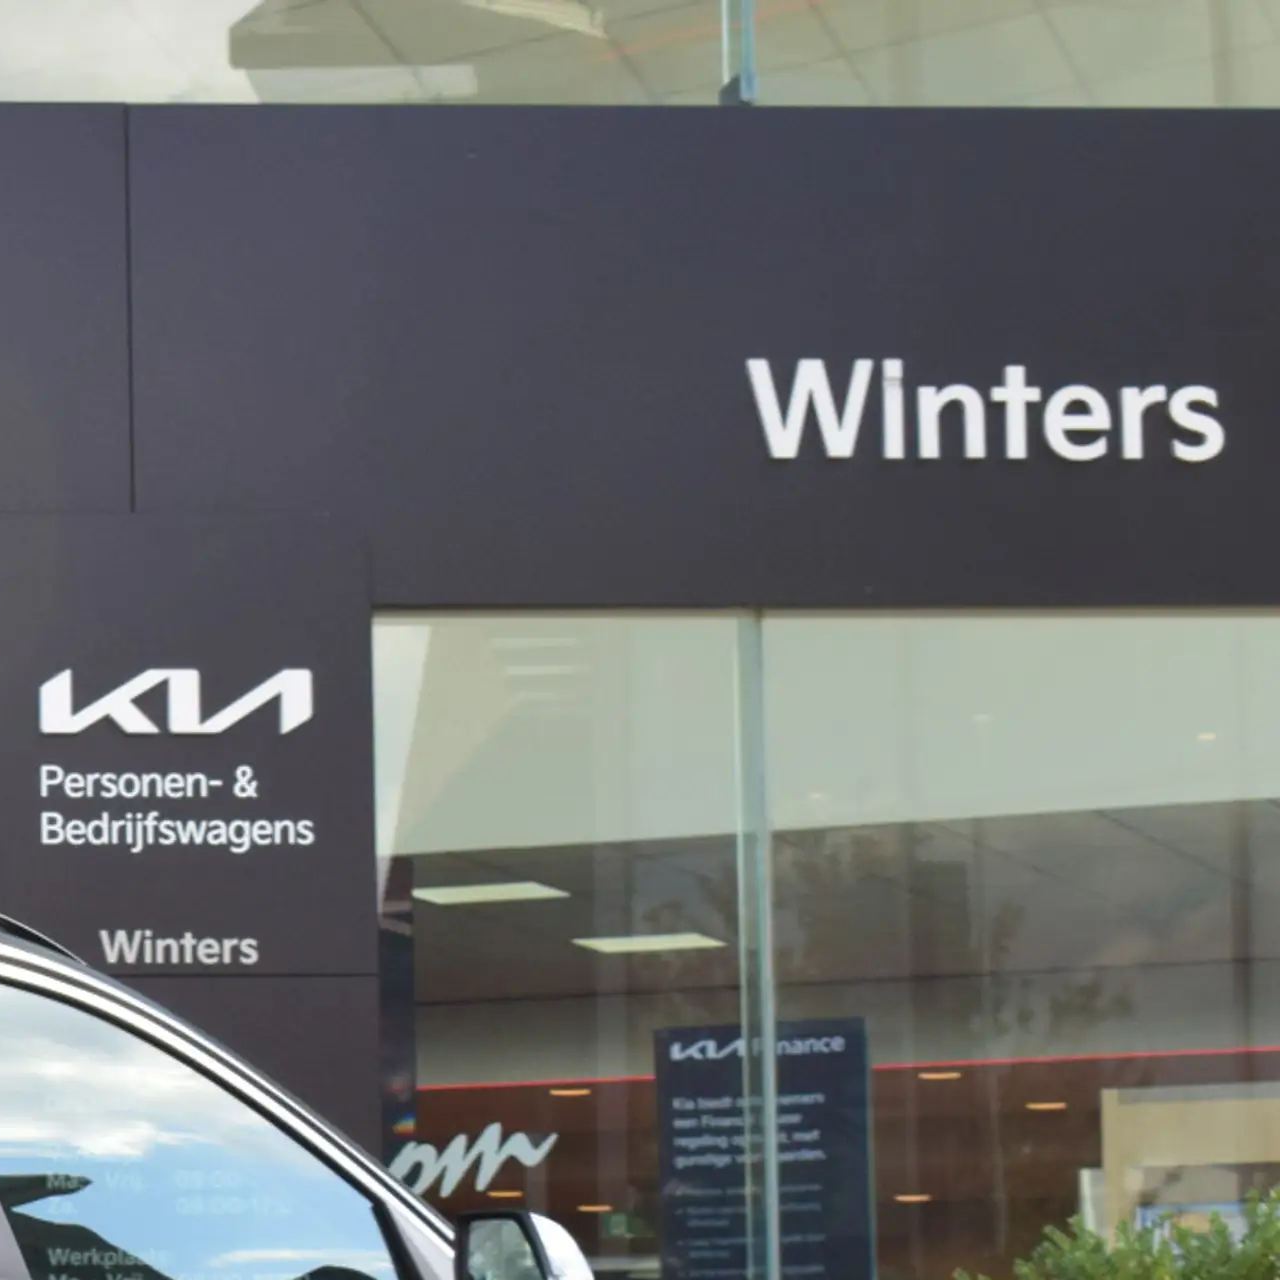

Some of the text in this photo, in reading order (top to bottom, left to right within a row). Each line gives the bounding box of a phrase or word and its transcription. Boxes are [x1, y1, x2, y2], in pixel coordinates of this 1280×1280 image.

[746, 358, 1225, 462] Winters
[39, 668, 313, 734] KIA
[39, 764, 258, 799] Personen- &
[40, 810, 315, 854] Bedrijfswagens
[99, 929, 259, 965] Winters
[751, 1034, 846, 1057] Fnance
